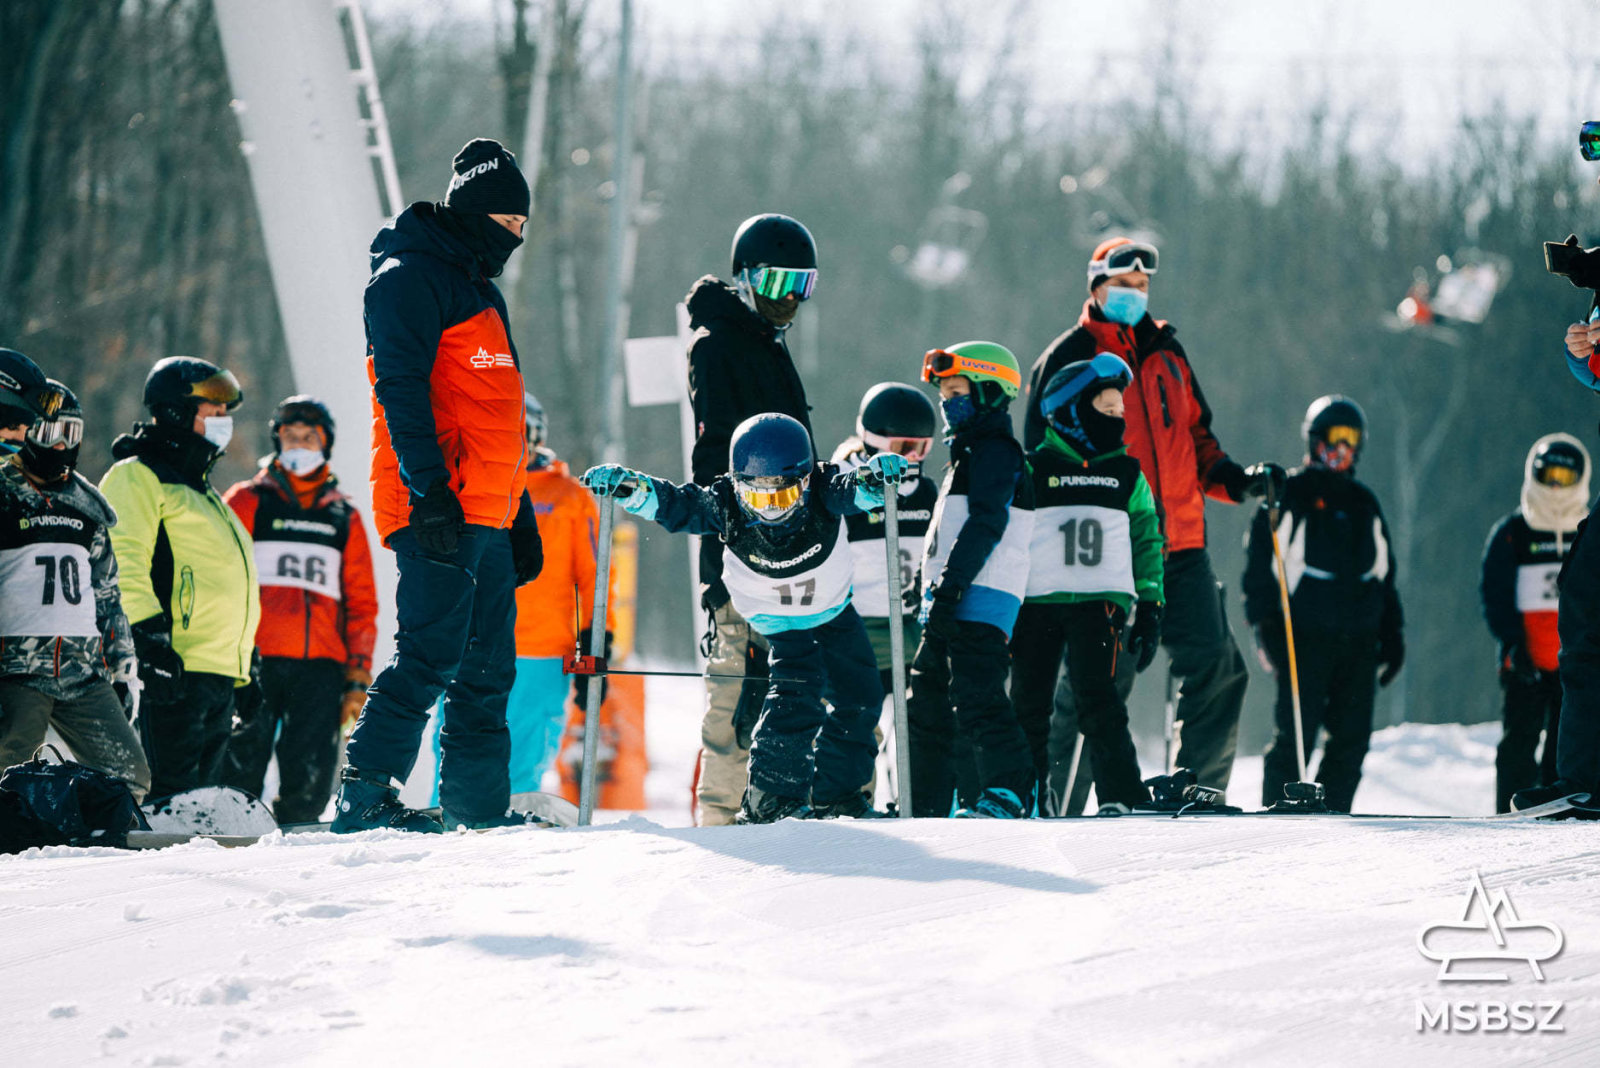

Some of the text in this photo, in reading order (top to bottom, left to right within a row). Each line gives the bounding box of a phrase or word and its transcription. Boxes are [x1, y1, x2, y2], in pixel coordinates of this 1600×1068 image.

[452, 158, 499, 190] URTON
[1060, 475, 1119, 488] FUNDANGO
[1058, 518, 1103, 567] 19
[35, 555, 82, 605] 70
[277, 553, 326, 586] 66
[771, 577, 816, 606] 17
